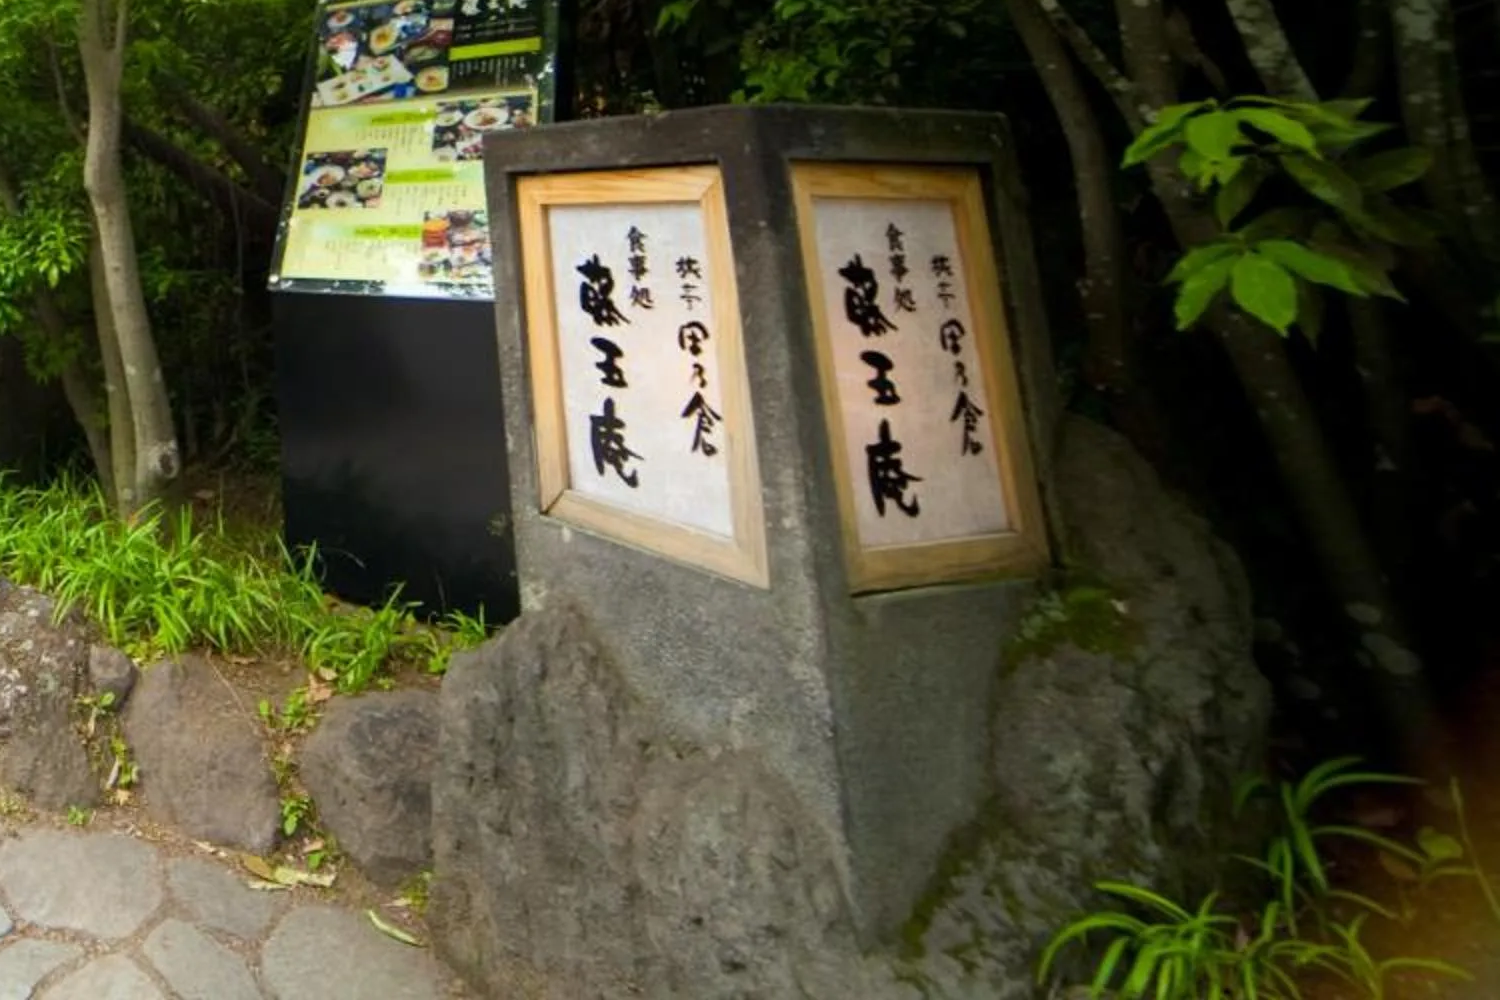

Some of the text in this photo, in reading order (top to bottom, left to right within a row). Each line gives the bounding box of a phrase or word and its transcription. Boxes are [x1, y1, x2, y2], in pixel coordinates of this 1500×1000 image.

[626, 225, 655, 310] 食事処
[885, 222, 917, 313] 食事処
